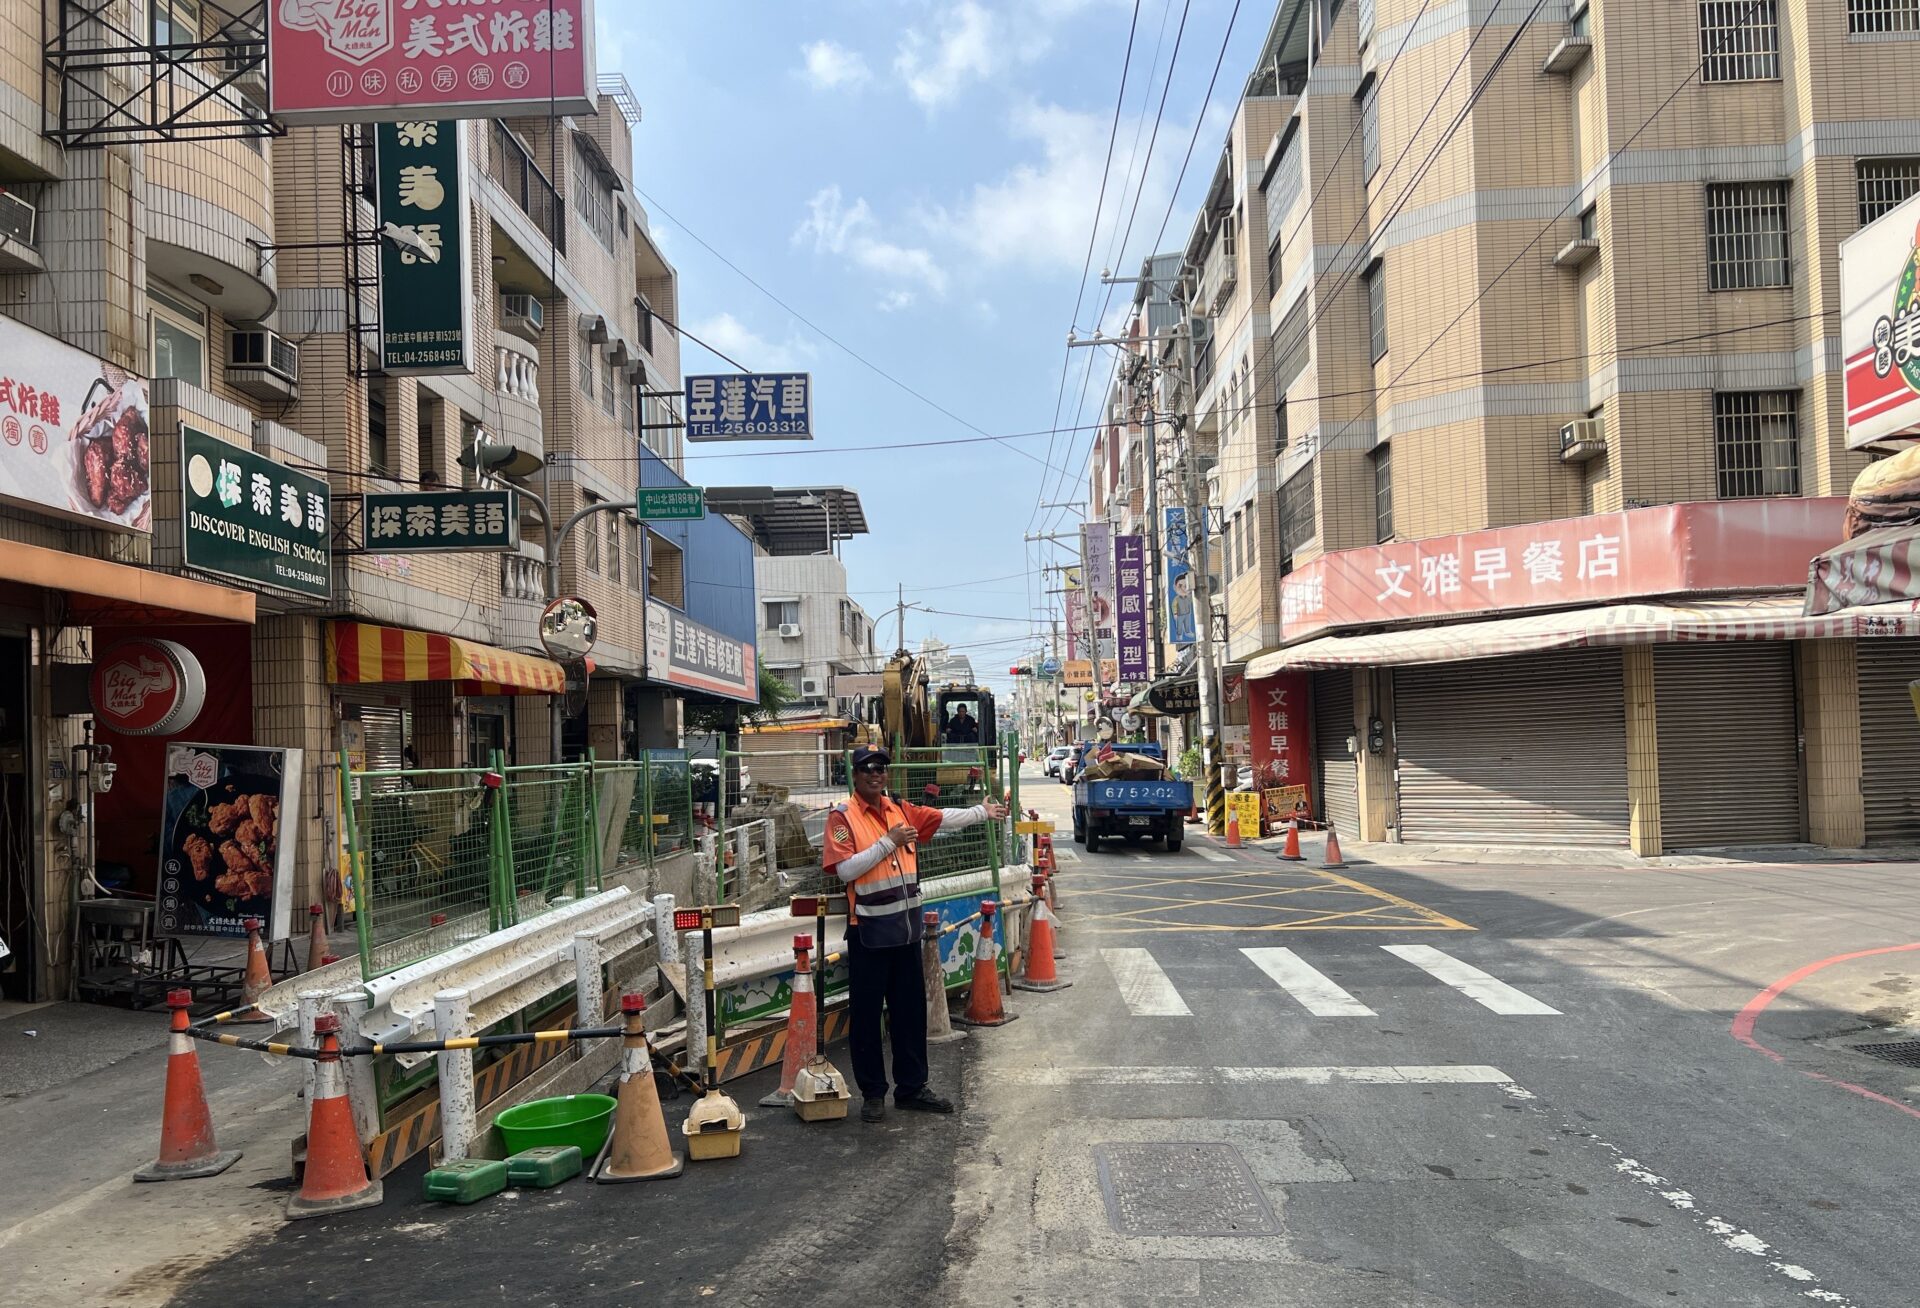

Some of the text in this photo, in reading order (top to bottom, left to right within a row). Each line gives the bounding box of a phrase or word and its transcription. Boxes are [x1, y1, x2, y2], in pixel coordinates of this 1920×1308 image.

[339, 20, 381, 39] Man
[402, 8, 576, 58] 美式炸雞
[387, 350, 461, 364] TEL:04-25684957
[689, 375, 806, 422] 昱達汽車
[691, 420, 806, 435] TEL:25603312
[217, 458, 326, 534] 探索美語
[190, 510, 327, 566] DISCOVER ENGLISH SCHOOL
[371, 503, 505, 538] 探索美語
[275, 564, 326, 587] TEL:04-25684957
[1375, 533, 1621, 602] 文雅早餐店
[1120, 542, 1142, 666] 上質感髮型
[674, 619, 743, 678] 昱達汽車修配廠
[107, 669, 136, 693] Big
[1121, 671, 1146, 680] 工作室
[110, 687, 137, 701] Man
[1267, 687, 1289, 779] 文雅早餐
[194, 759, 212, 775] Big
